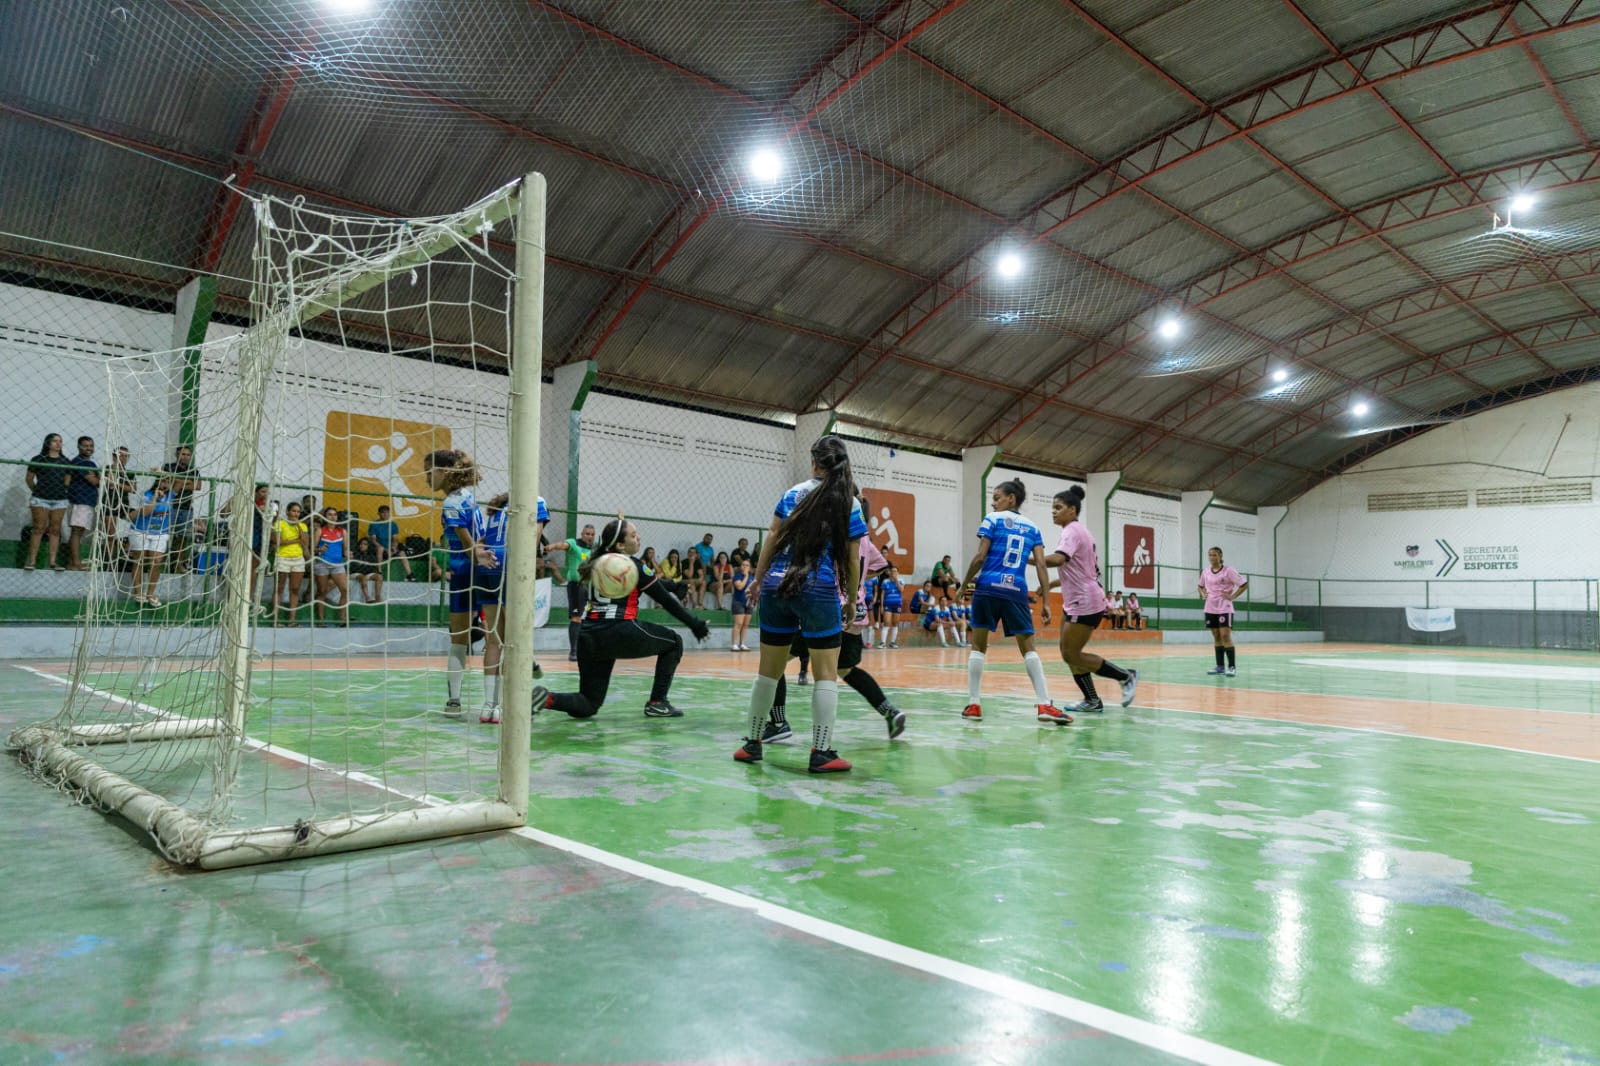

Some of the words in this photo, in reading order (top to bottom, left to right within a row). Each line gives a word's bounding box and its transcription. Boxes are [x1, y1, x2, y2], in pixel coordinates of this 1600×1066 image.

[1003, 534, 1024, 569] 8
[1463, 545, 1519, 554] SECRETARIA
[1508, 553, 1519, 561] DE
[1463, 561, 1519, 570] ESPORTES
